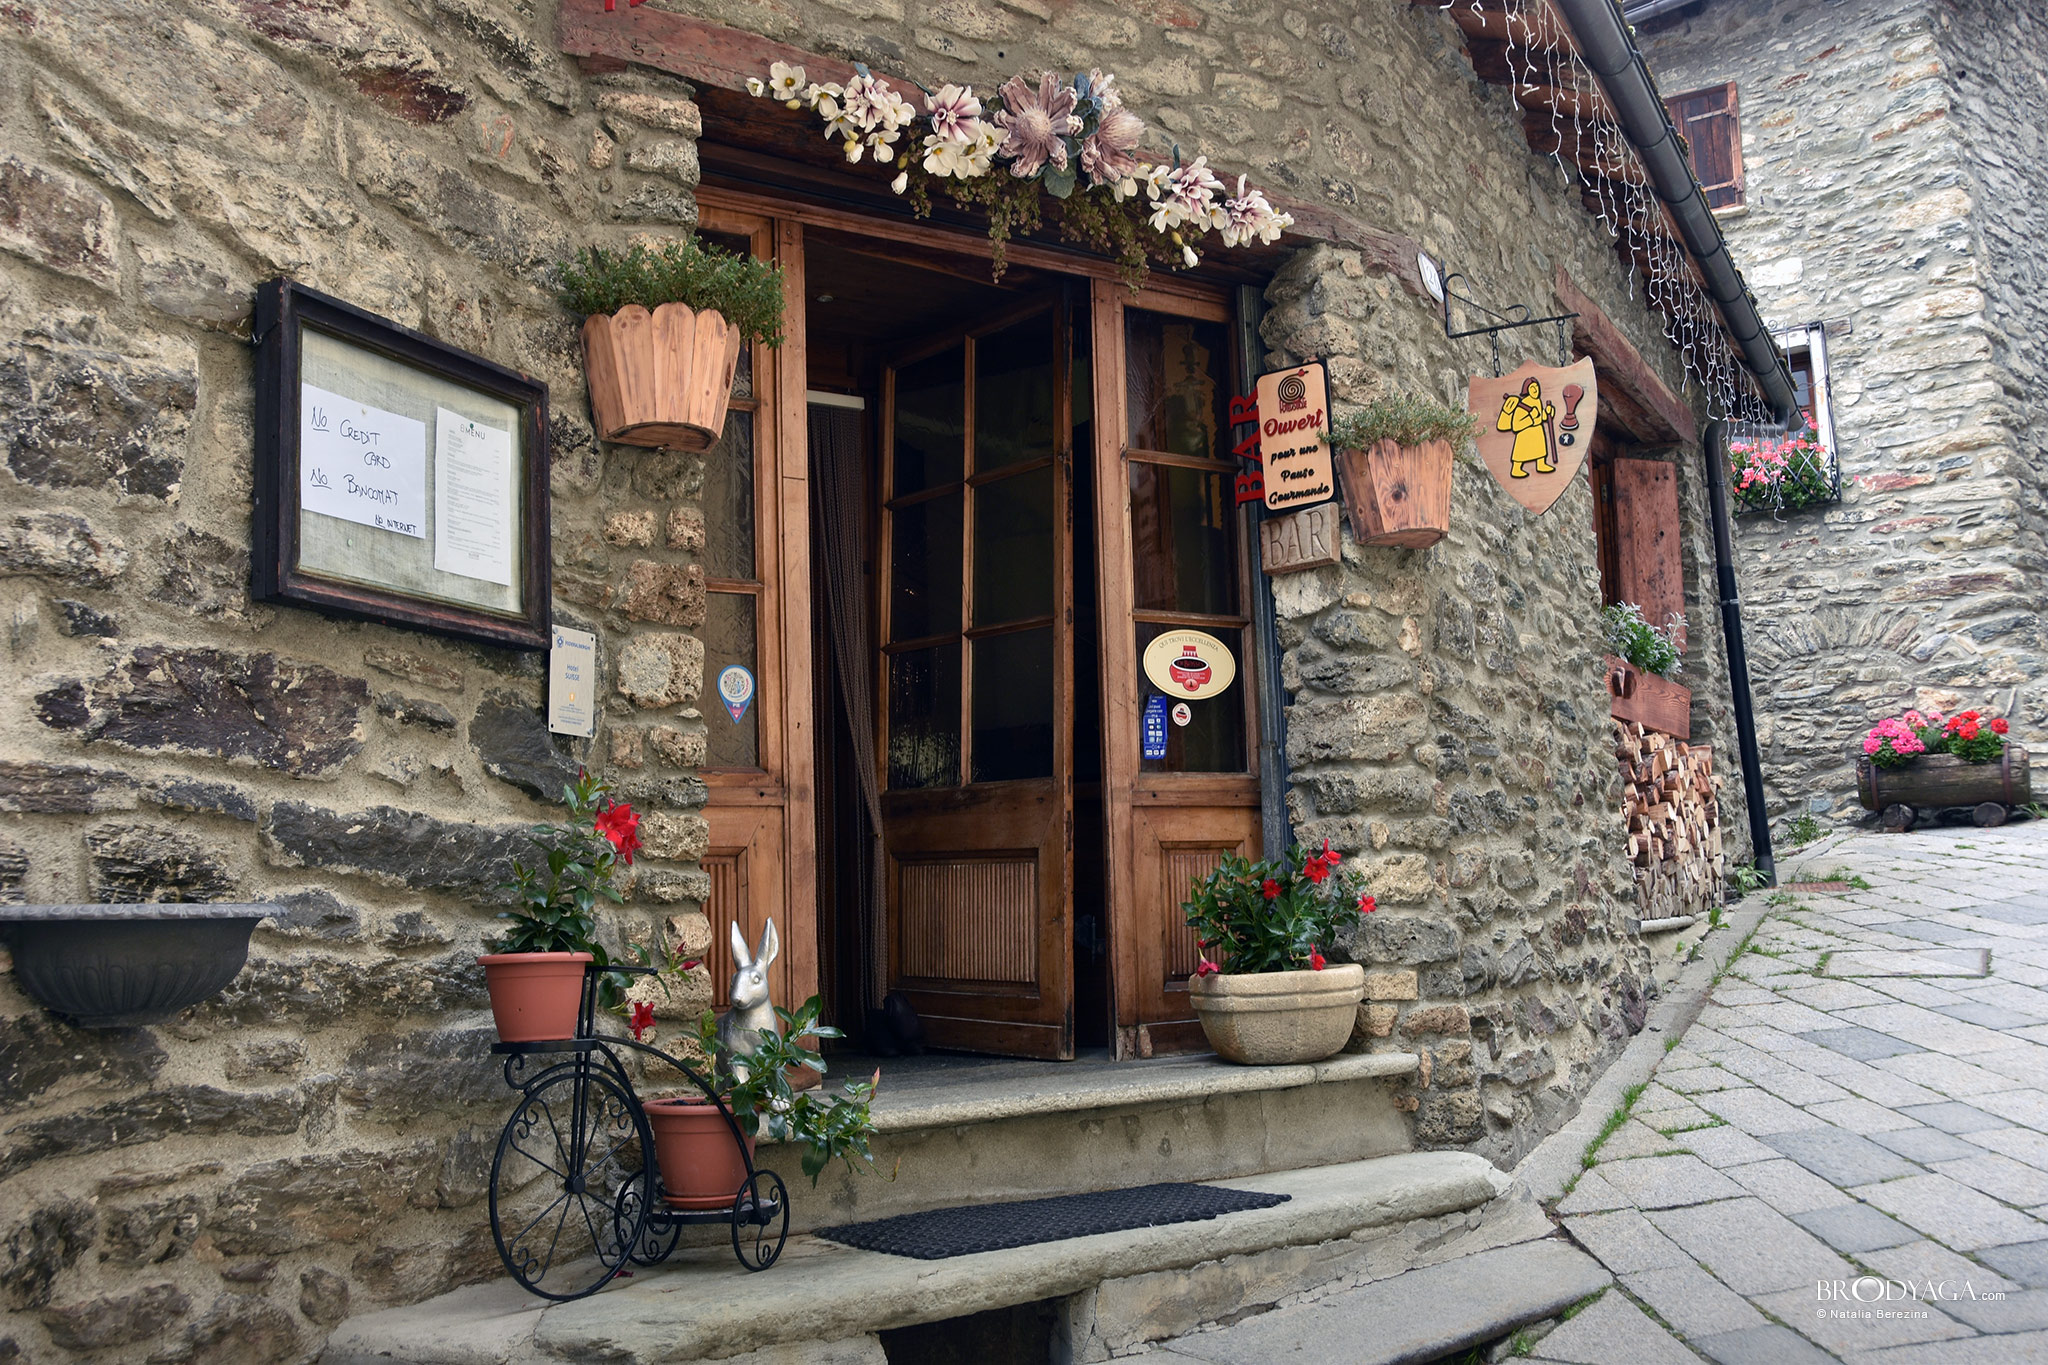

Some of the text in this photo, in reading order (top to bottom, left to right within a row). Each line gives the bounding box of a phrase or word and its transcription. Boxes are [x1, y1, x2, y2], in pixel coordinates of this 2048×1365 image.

[1263, 408, 1323, 437] Ouvert
[1230, 387, 1265, 508] BAR
[1270, 445, 1319, 465] pour une
[363, 451, 391, 470] CARD
[1280, 467, 1315, 483] Pause
[343, 474, 398, 506] BANCOMAT
[1268, 483, 1330, 505] Gourmande
[386, 519, 417, 535] INTERNET
[1266, 510, 1328, 567] BAR
[1169, 636, 1184, 644] TROVI
